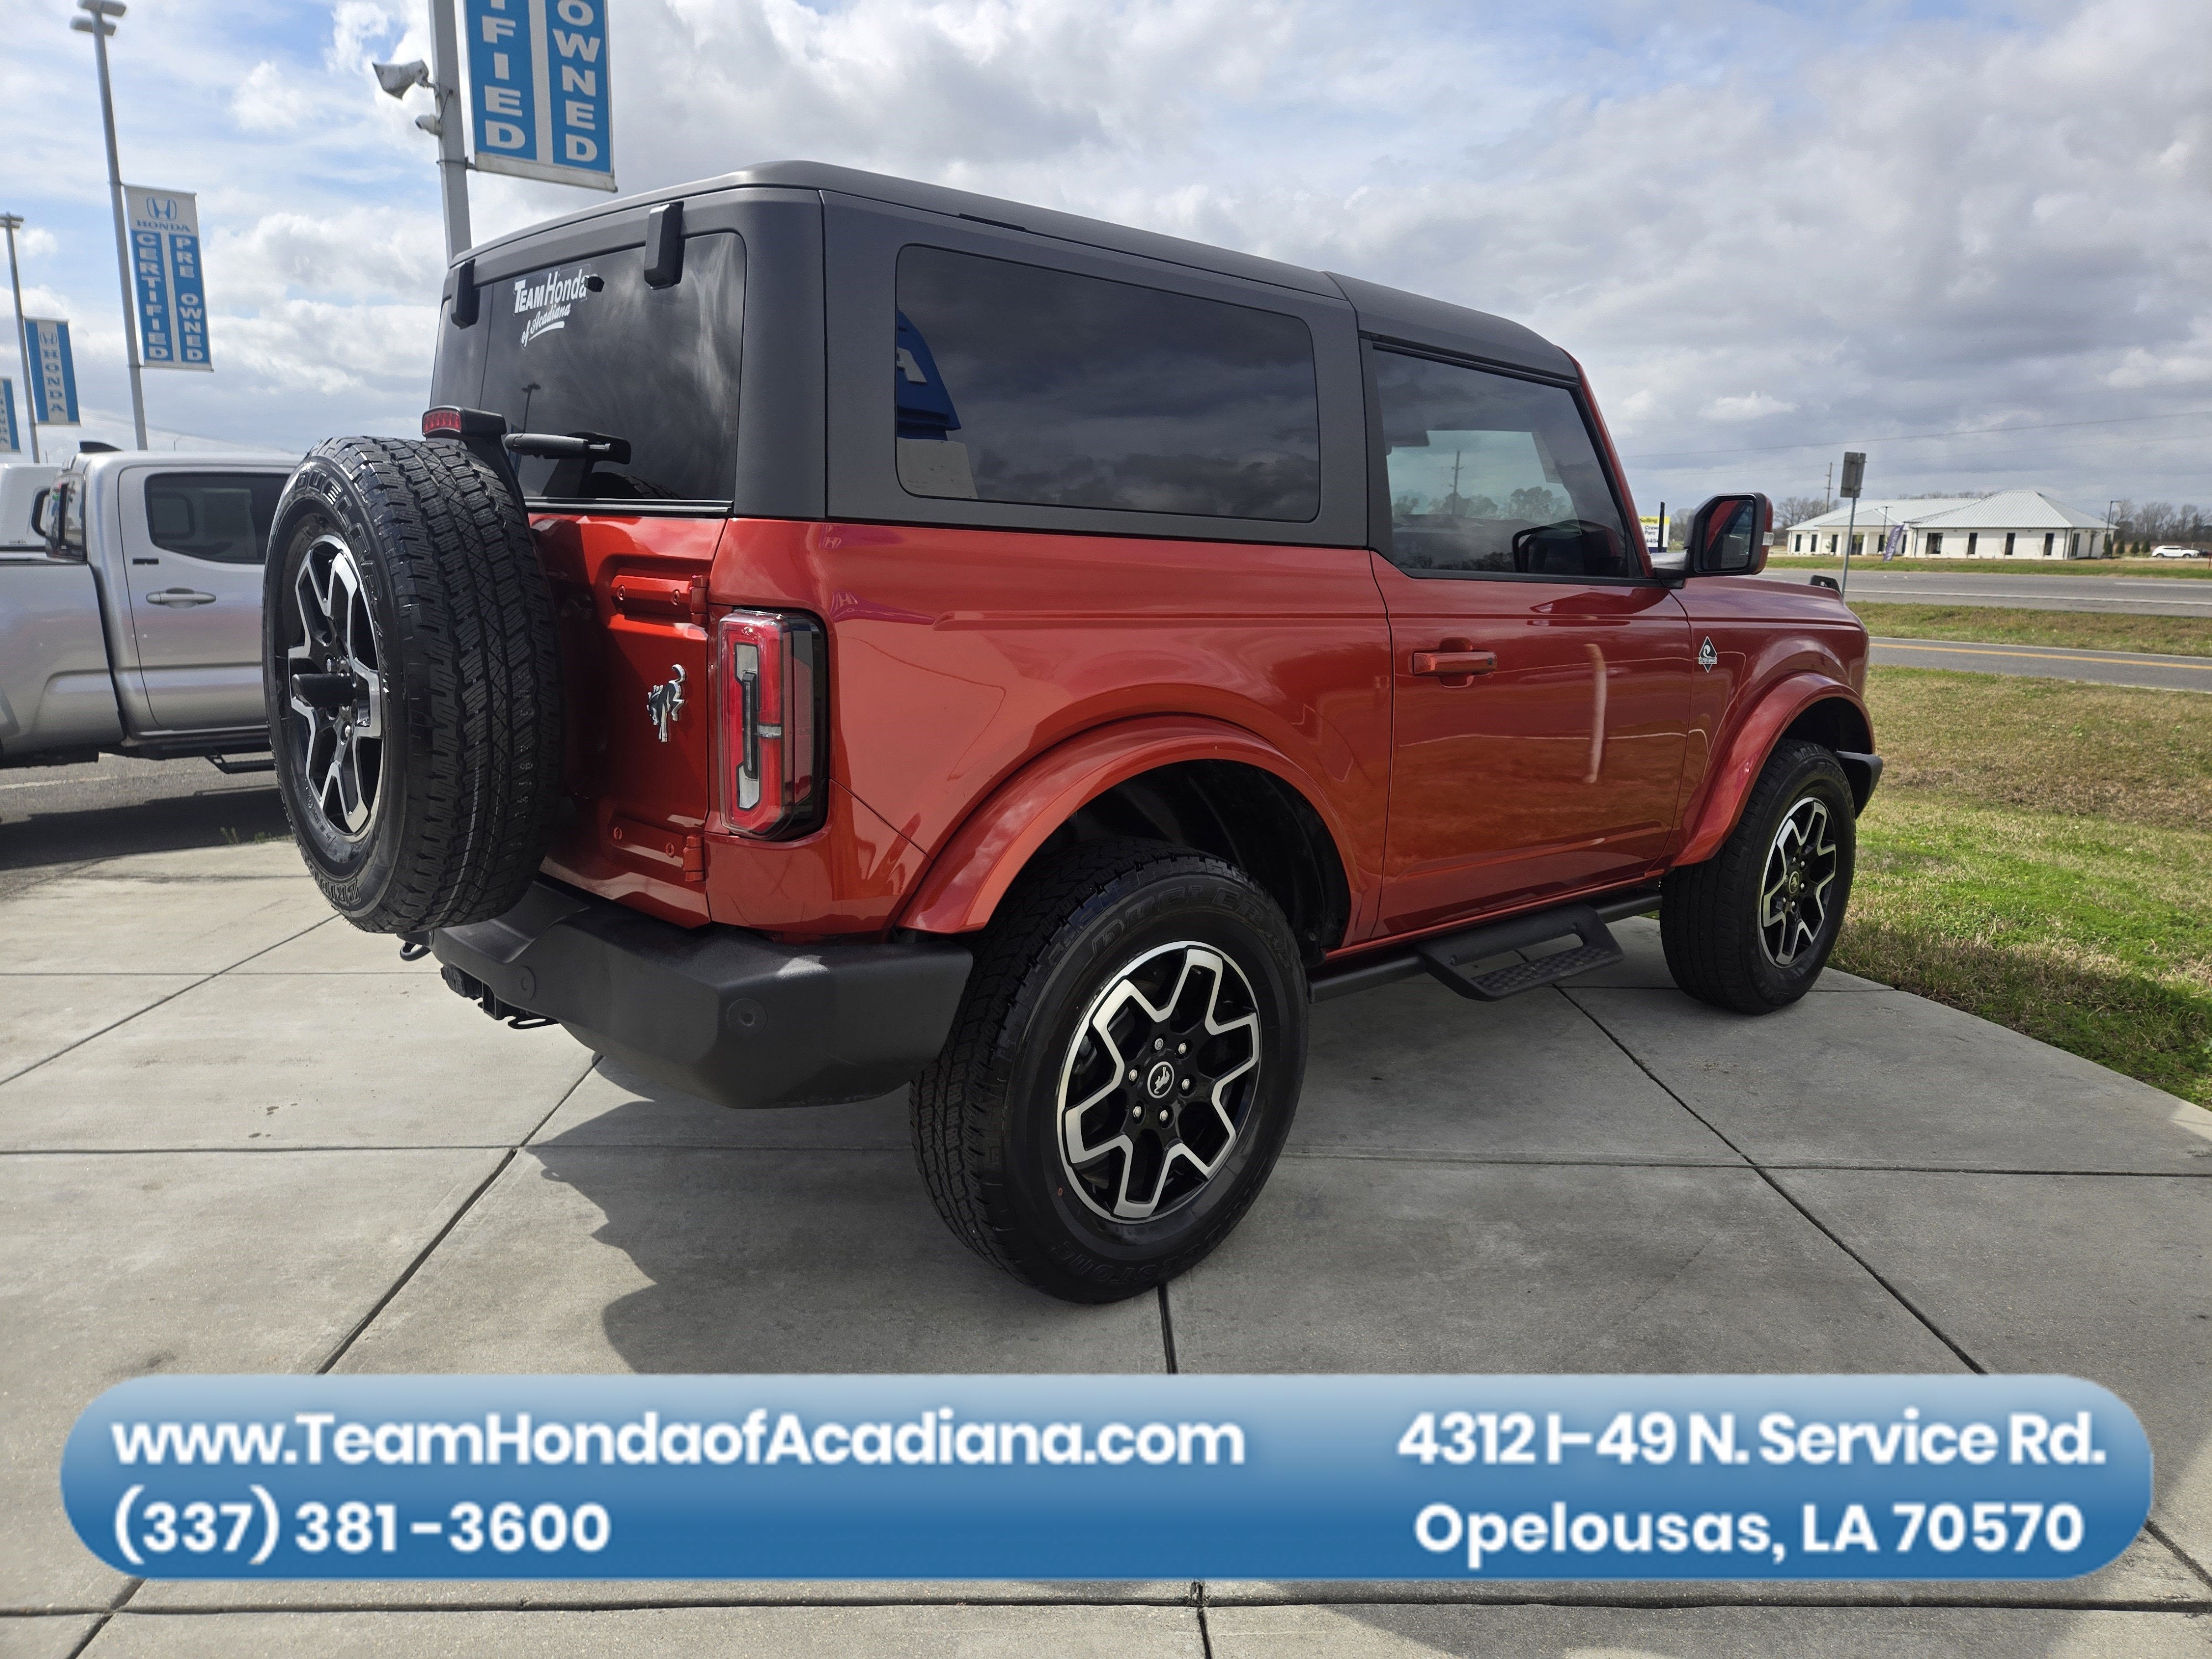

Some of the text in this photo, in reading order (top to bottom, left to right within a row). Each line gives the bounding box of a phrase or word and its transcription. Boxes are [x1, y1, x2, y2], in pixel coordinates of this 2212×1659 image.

[553, 0, 601, 162] OWNED
[136, 220, 191, 233] HONDA
[137, 233, 168, 359] CERTIFIED
[176, 237, 204, 361] PRE OWNED
[544, 269, 587, 306] Honda
[521, 302, 571, 347] of Acadiana
[43, 349, 65, 413] HONDA
